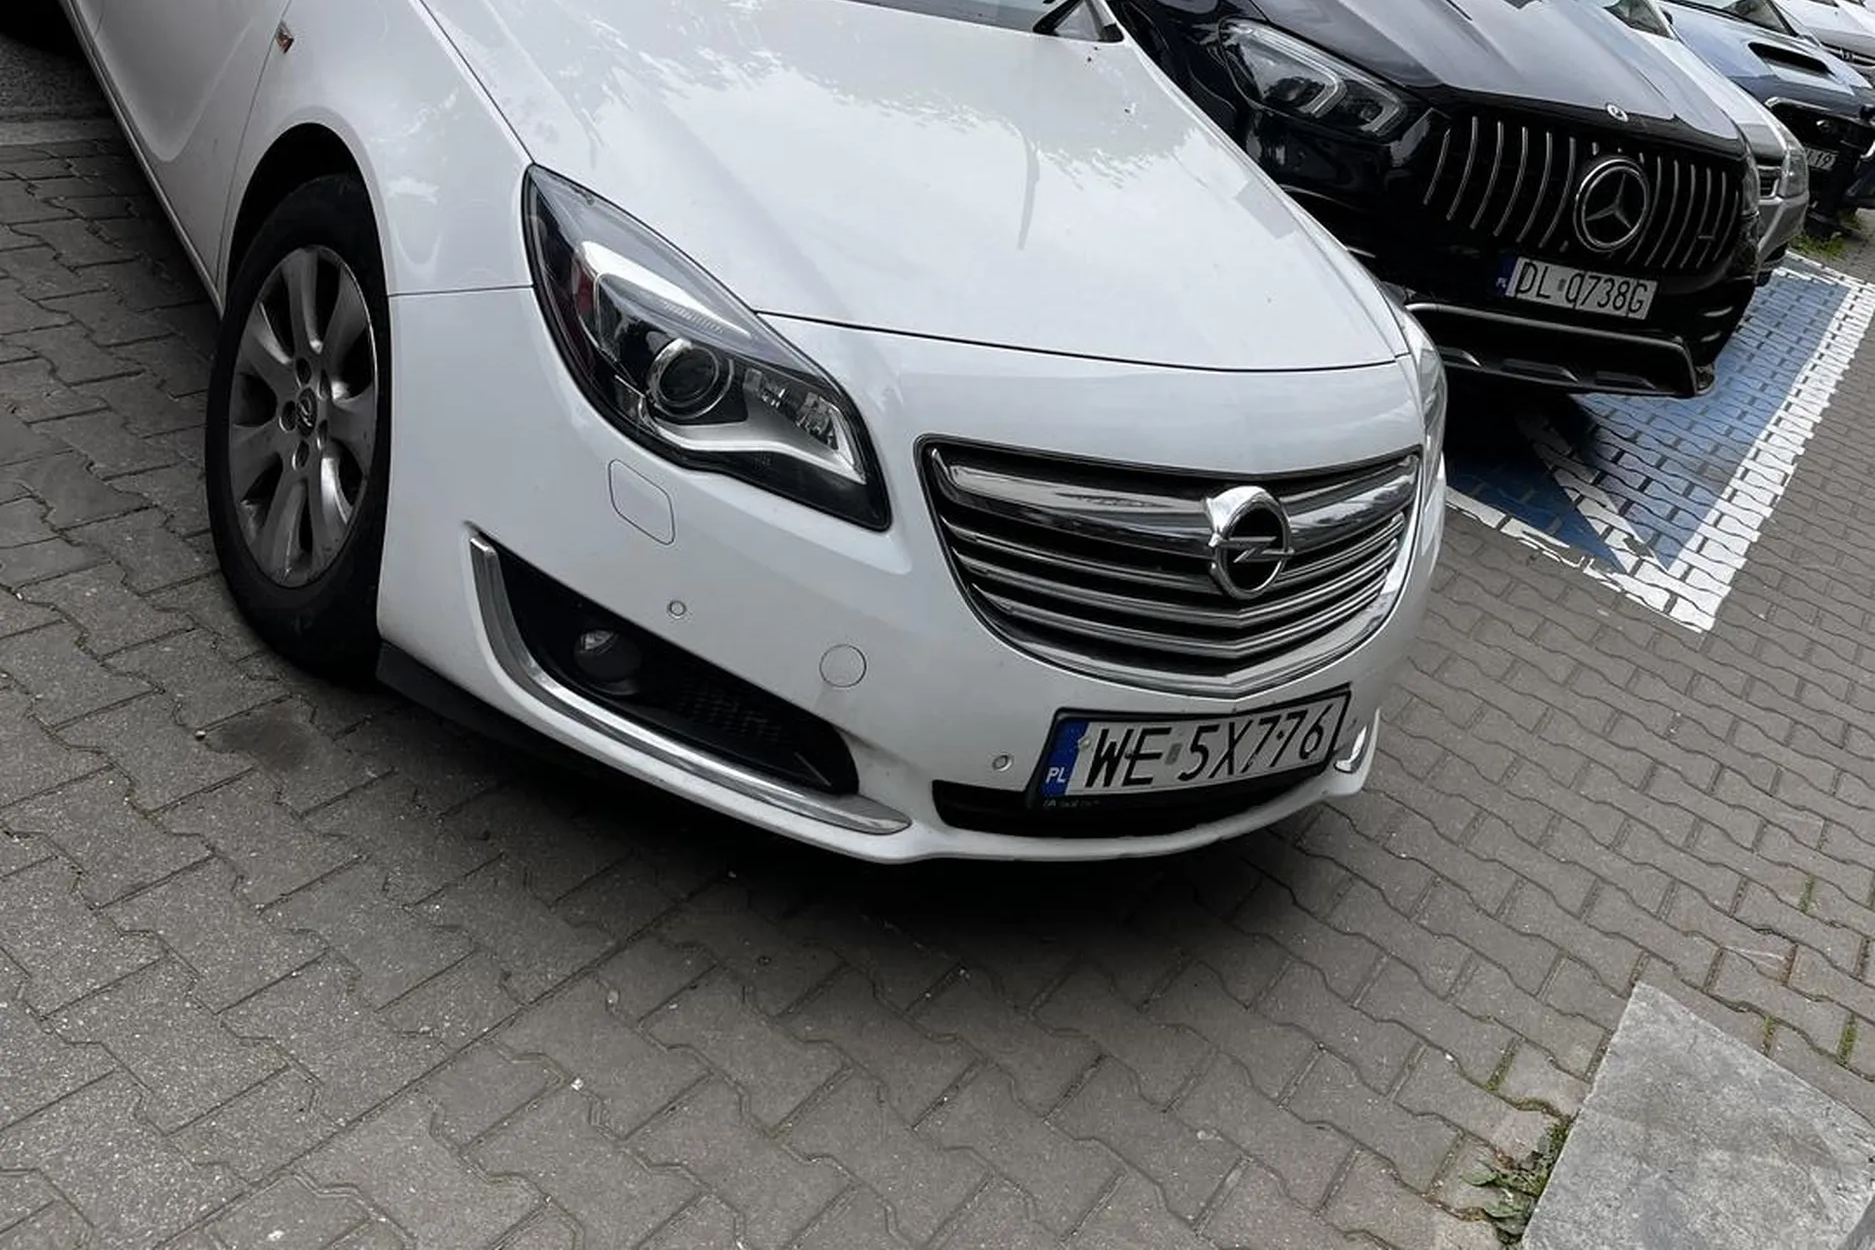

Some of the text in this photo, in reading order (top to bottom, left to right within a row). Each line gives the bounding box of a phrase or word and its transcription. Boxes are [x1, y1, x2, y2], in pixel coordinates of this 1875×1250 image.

[1515, 261, 1551, 299] DL
[1085, 703, 1334, 787] WE 5X776
[1045, 766, 1066, 784] PL
